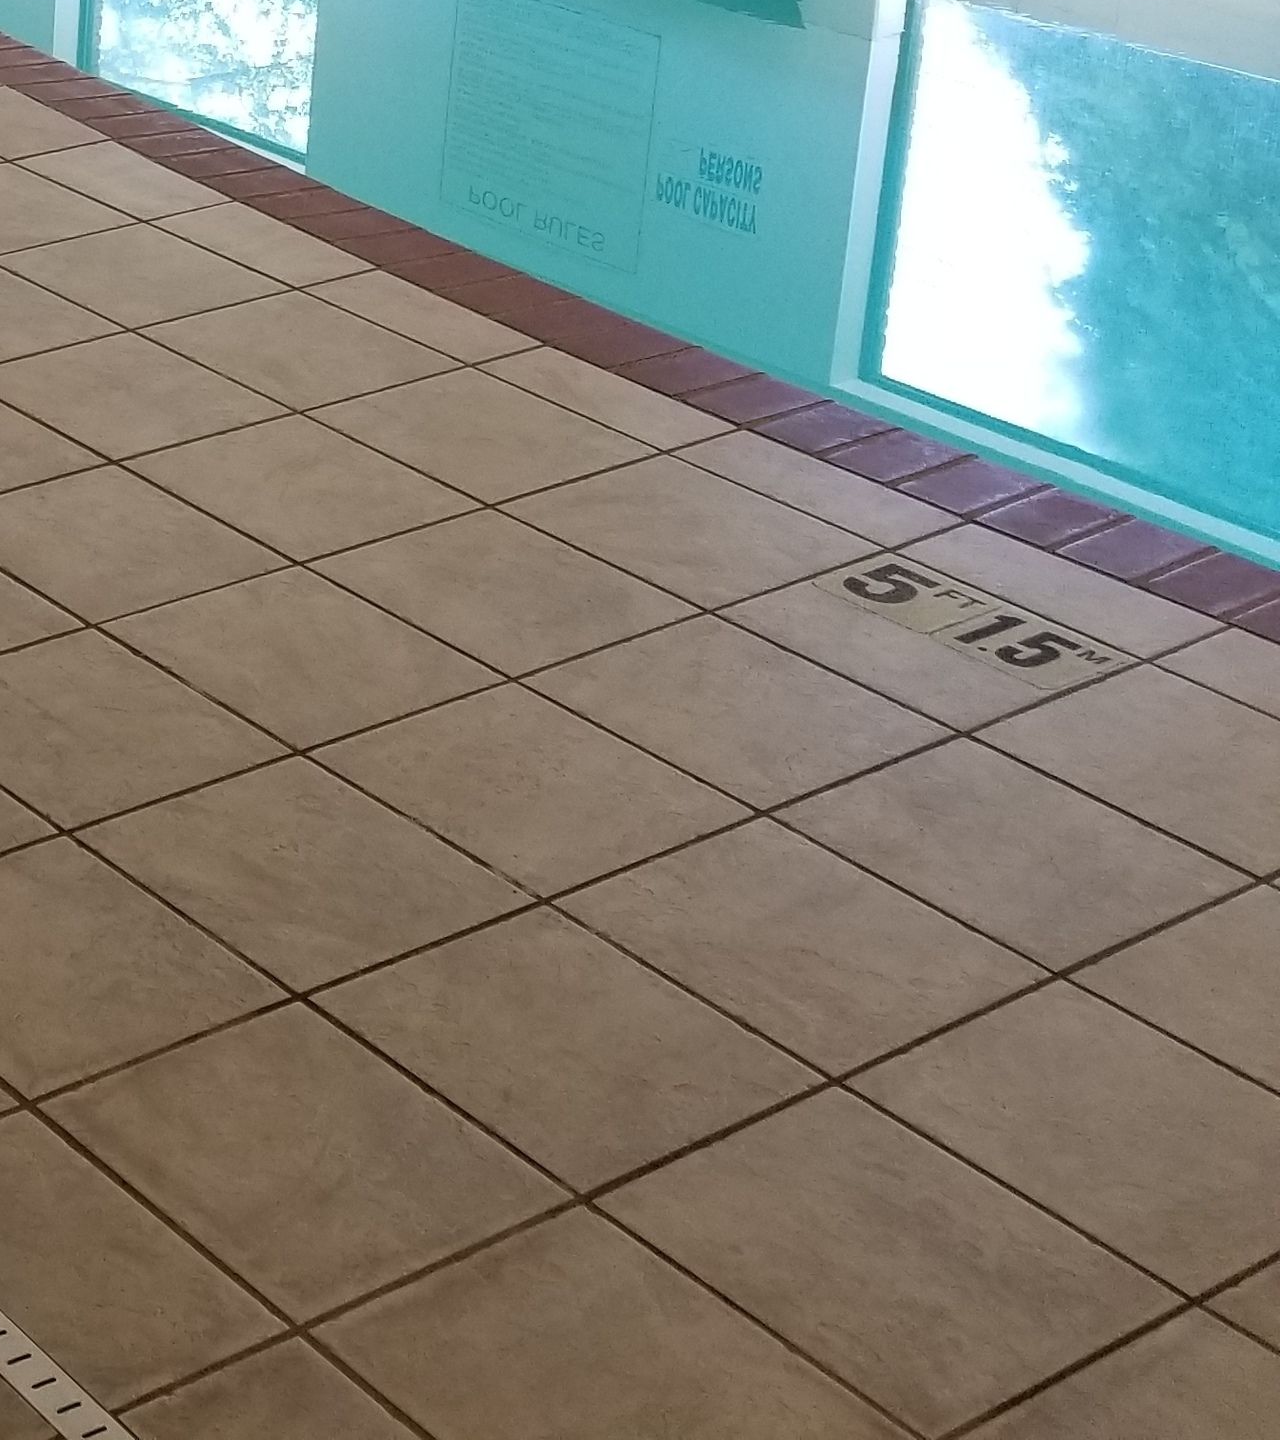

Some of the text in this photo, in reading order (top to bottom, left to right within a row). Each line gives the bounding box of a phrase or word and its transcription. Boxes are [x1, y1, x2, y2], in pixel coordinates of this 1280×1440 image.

[843, 564, 1112, 667] 5 FT 1.5 M
